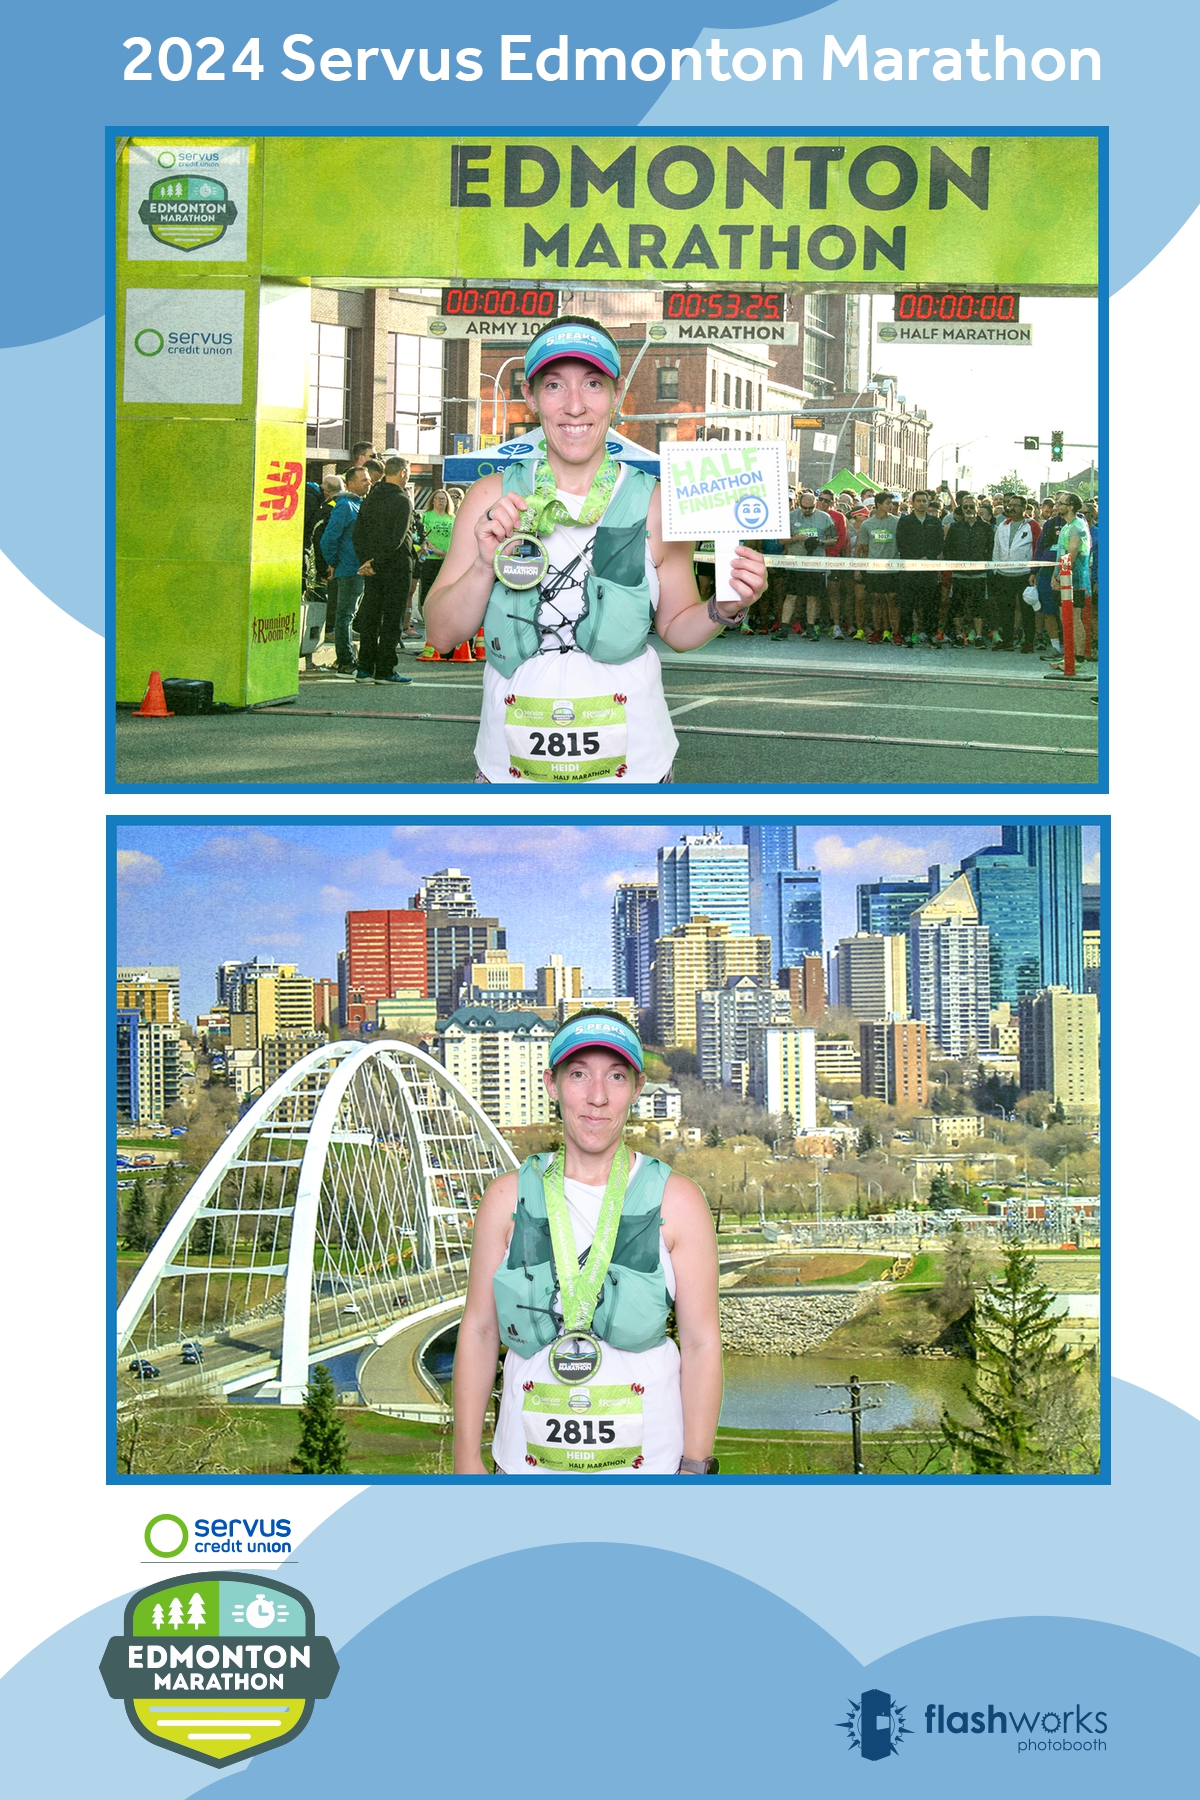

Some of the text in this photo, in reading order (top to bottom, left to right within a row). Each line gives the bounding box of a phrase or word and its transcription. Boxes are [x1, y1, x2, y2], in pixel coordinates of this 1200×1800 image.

[178, 152, 219, 161] servus
[450, 144, 991, 211] EDMONTON
[150, 203, 227, 214] EDMONTON
[160, 214, 216, 223] MARATHON
[523, 222, 907, 271] MARATHON
[465, 321, 518, 335] ARMY
[678, 324, 785, 340] MARATHON
[900, 328, 1031, 341] HALF MARATHON
[168, 332, 233, 345] servus
[546, 335, 556, 347] 5
[557, 332, 599, 343] PEAKS
[167, 346, 233, 355] credit union
[671, 447, 758, 487] HALF
[676, 470, 764, 500] MARATHON
[678, 483, 768, 516] FINISHER!
[257, 612, 290, 634] Running
[529, 731, 600, 757] 2815
[551, 764, 579, 772] HEIDI
[572, 769, 611, 780] MARATHON
[575, 1026, 584, 1035] 5
[587, 1024, 626, 1036] PEAKS
[546, 1418, 616, 1444] 2815
[566, 1452, 595, 1460] HEIDI
[587, 1459, 626, 1469] MARATHON
